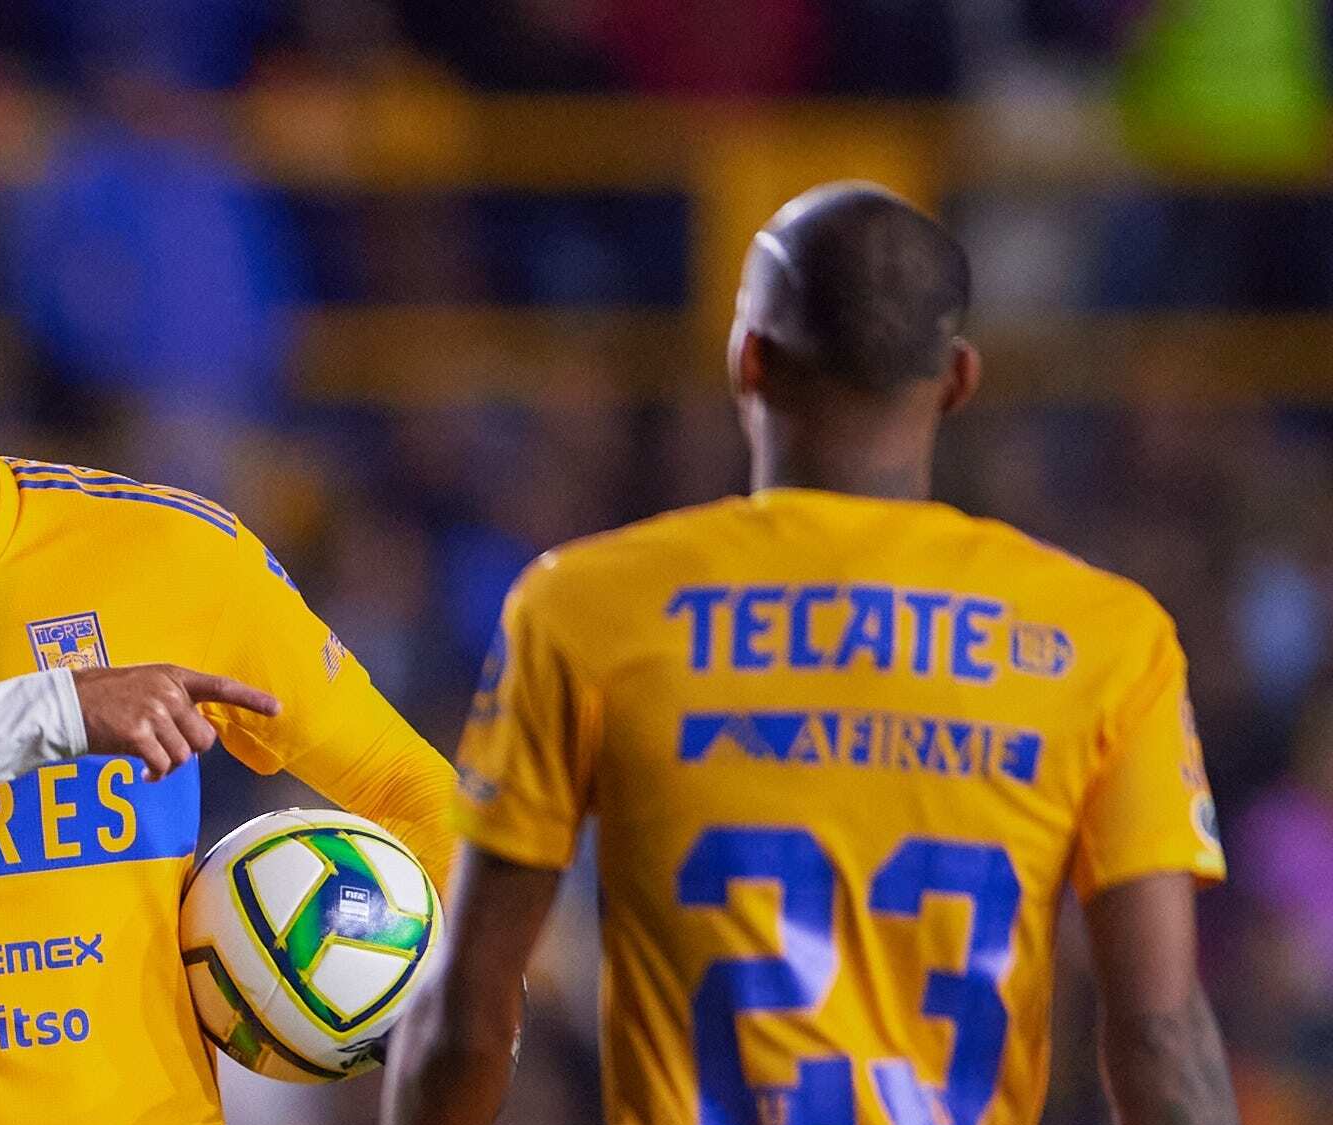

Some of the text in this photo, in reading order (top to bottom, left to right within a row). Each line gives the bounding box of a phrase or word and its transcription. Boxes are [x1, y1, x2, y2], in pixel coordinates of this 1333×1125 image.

[36, 621, 93, 642] TIGRES
[666, 586, 1004, 681] TECATE
[791, 713, 1023, 779] AFIRME
